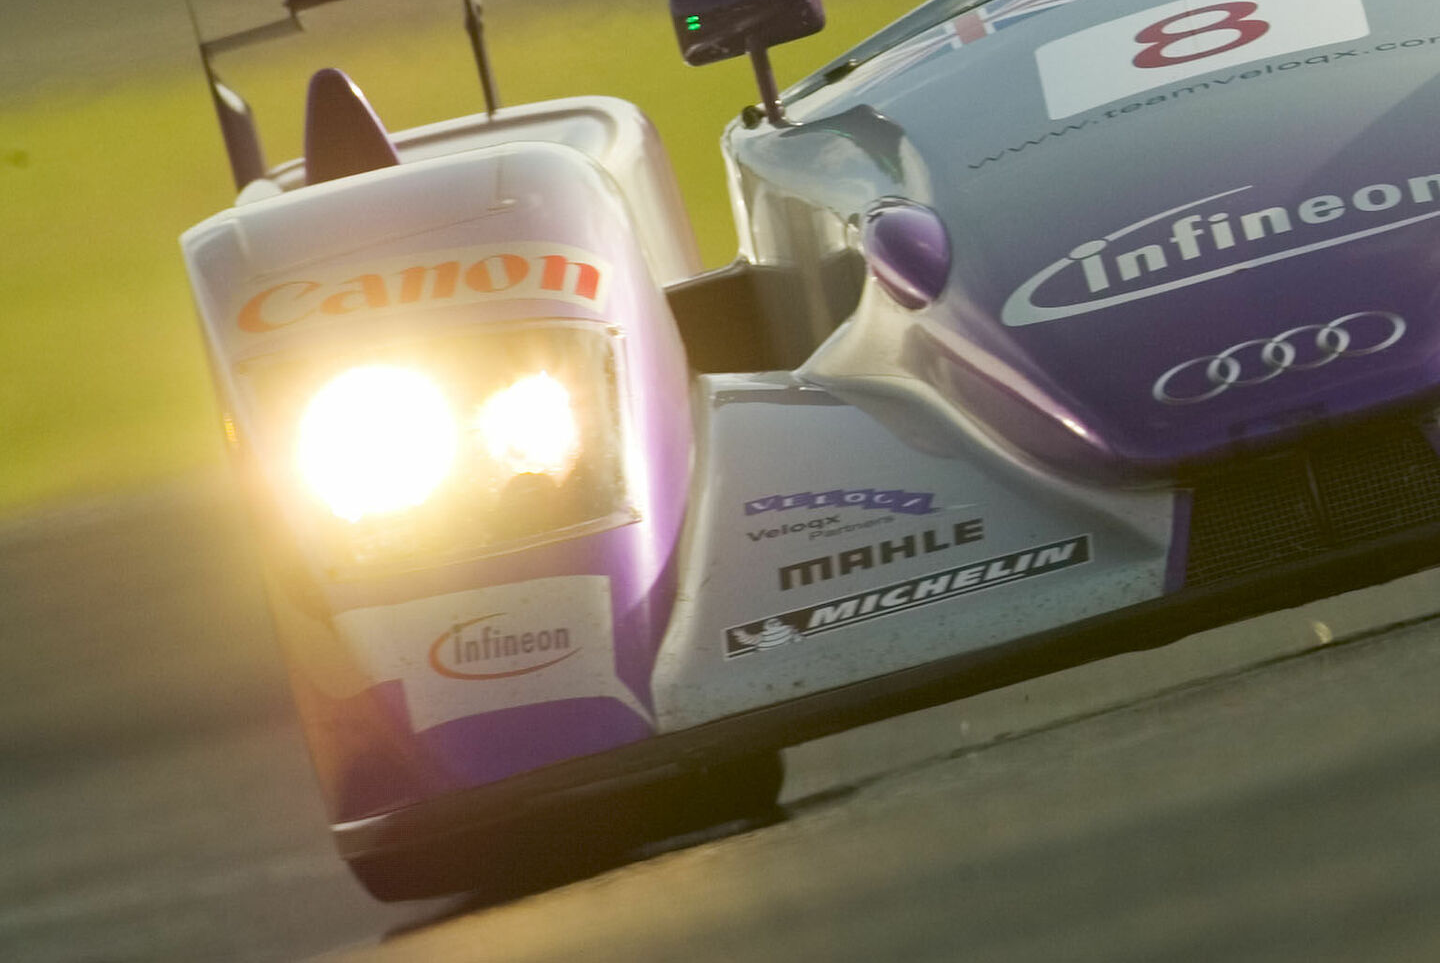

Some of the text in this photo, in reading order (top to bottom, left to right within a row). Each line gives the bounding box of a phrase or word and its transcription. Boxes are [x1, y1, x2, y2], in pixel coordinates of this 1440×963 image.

[1132, 0, 1271, 69] 8
[237, 253, 600, 333] Canon
[747, 514, 840, 542] Veloqx
[779, 518, 985, 592] MAHLE
[809, 516, 894, 540] Partners
[807, 542, 1078, 630] MICHELIN
